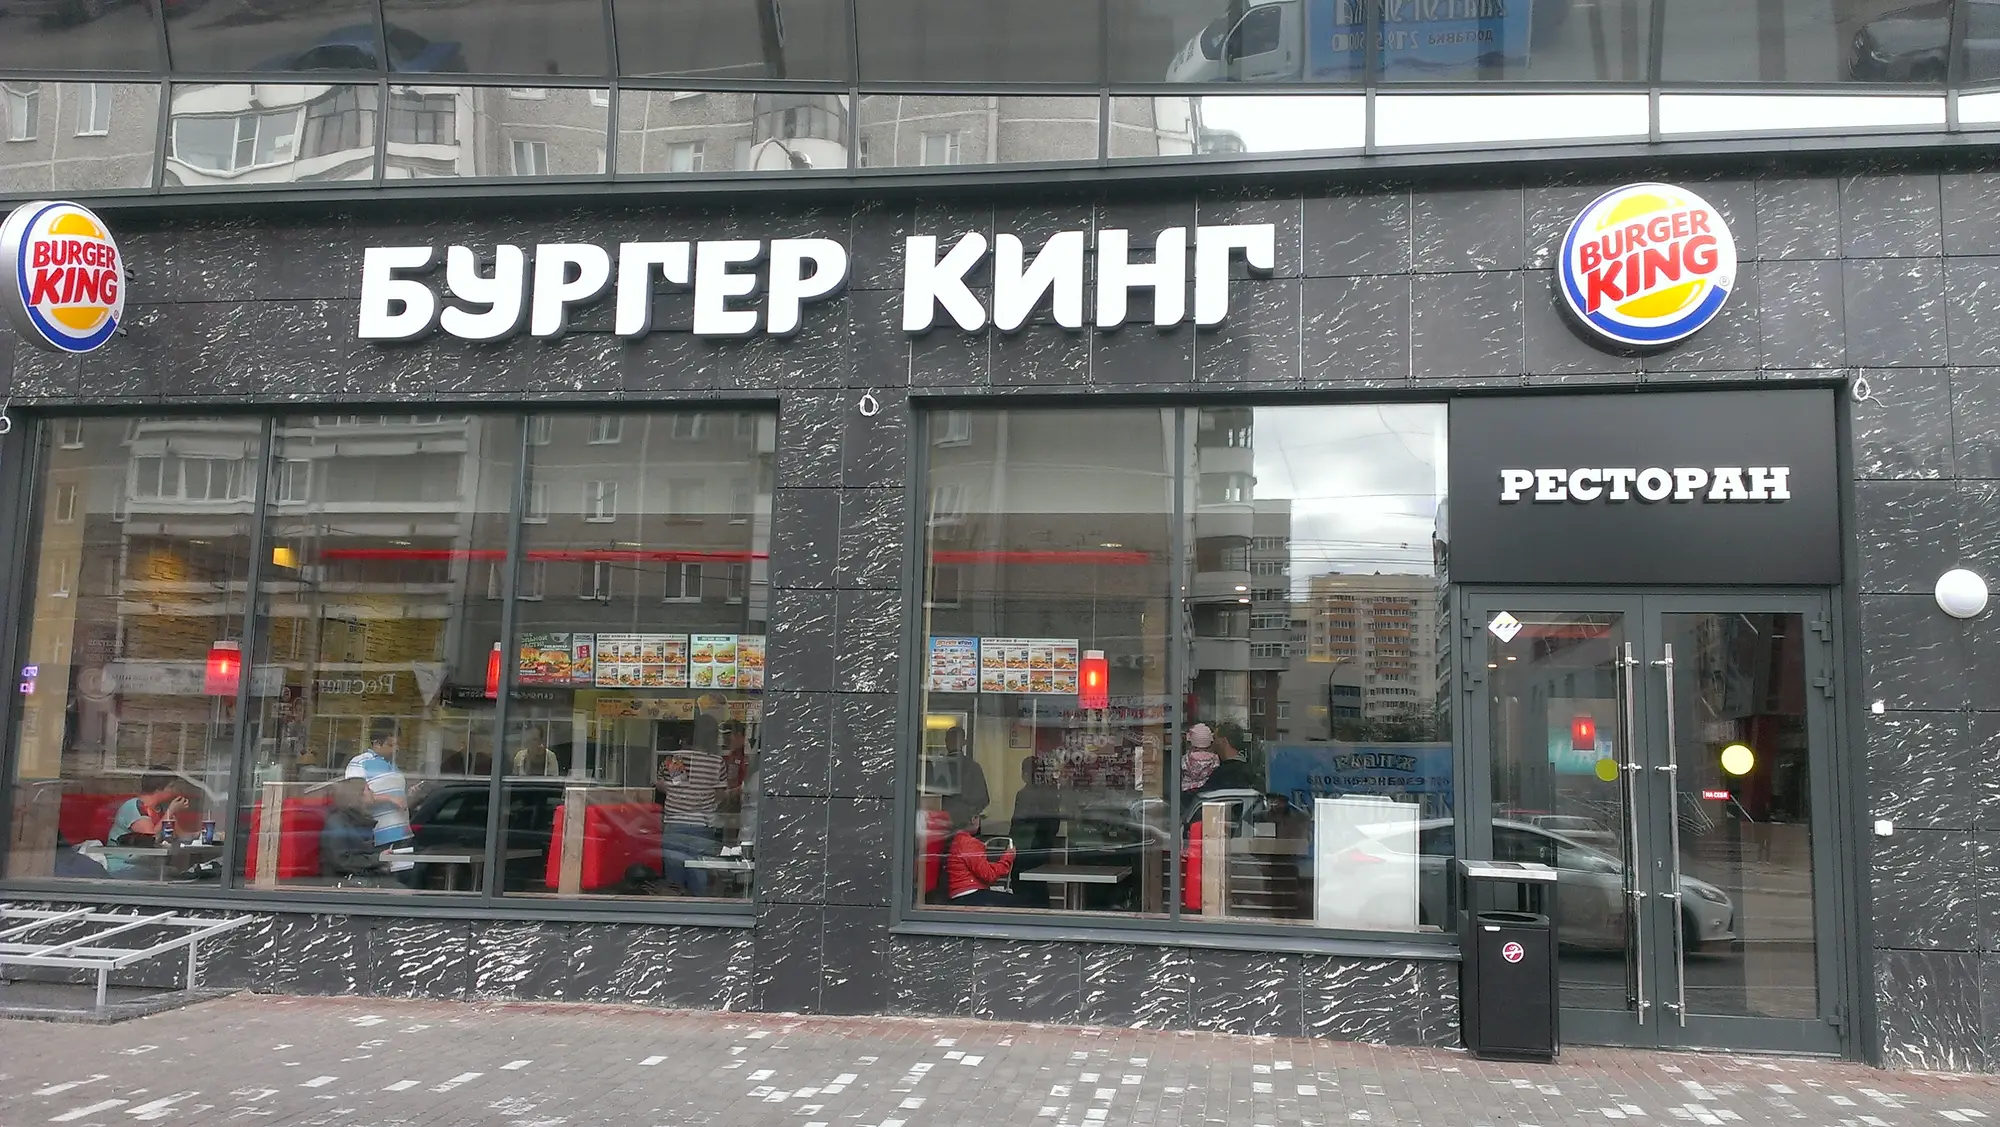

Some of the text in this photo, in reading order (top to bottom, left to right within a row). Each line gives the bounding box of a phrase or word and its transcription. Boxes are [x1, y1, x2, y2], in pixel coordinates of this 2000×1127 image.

[32, 240, 117, 271] BURGER
[1579, 209, 1711, 275] BURGER
[30, 267, 119, 306] KING
[357, 223, 1276, 340] БУРГЕР КИНГ
[1586, 234, 1719, 314] KING
[1499, 466, 1792, 502] РЕСТОРАН
[1705, 790, 1713, 798] НА
